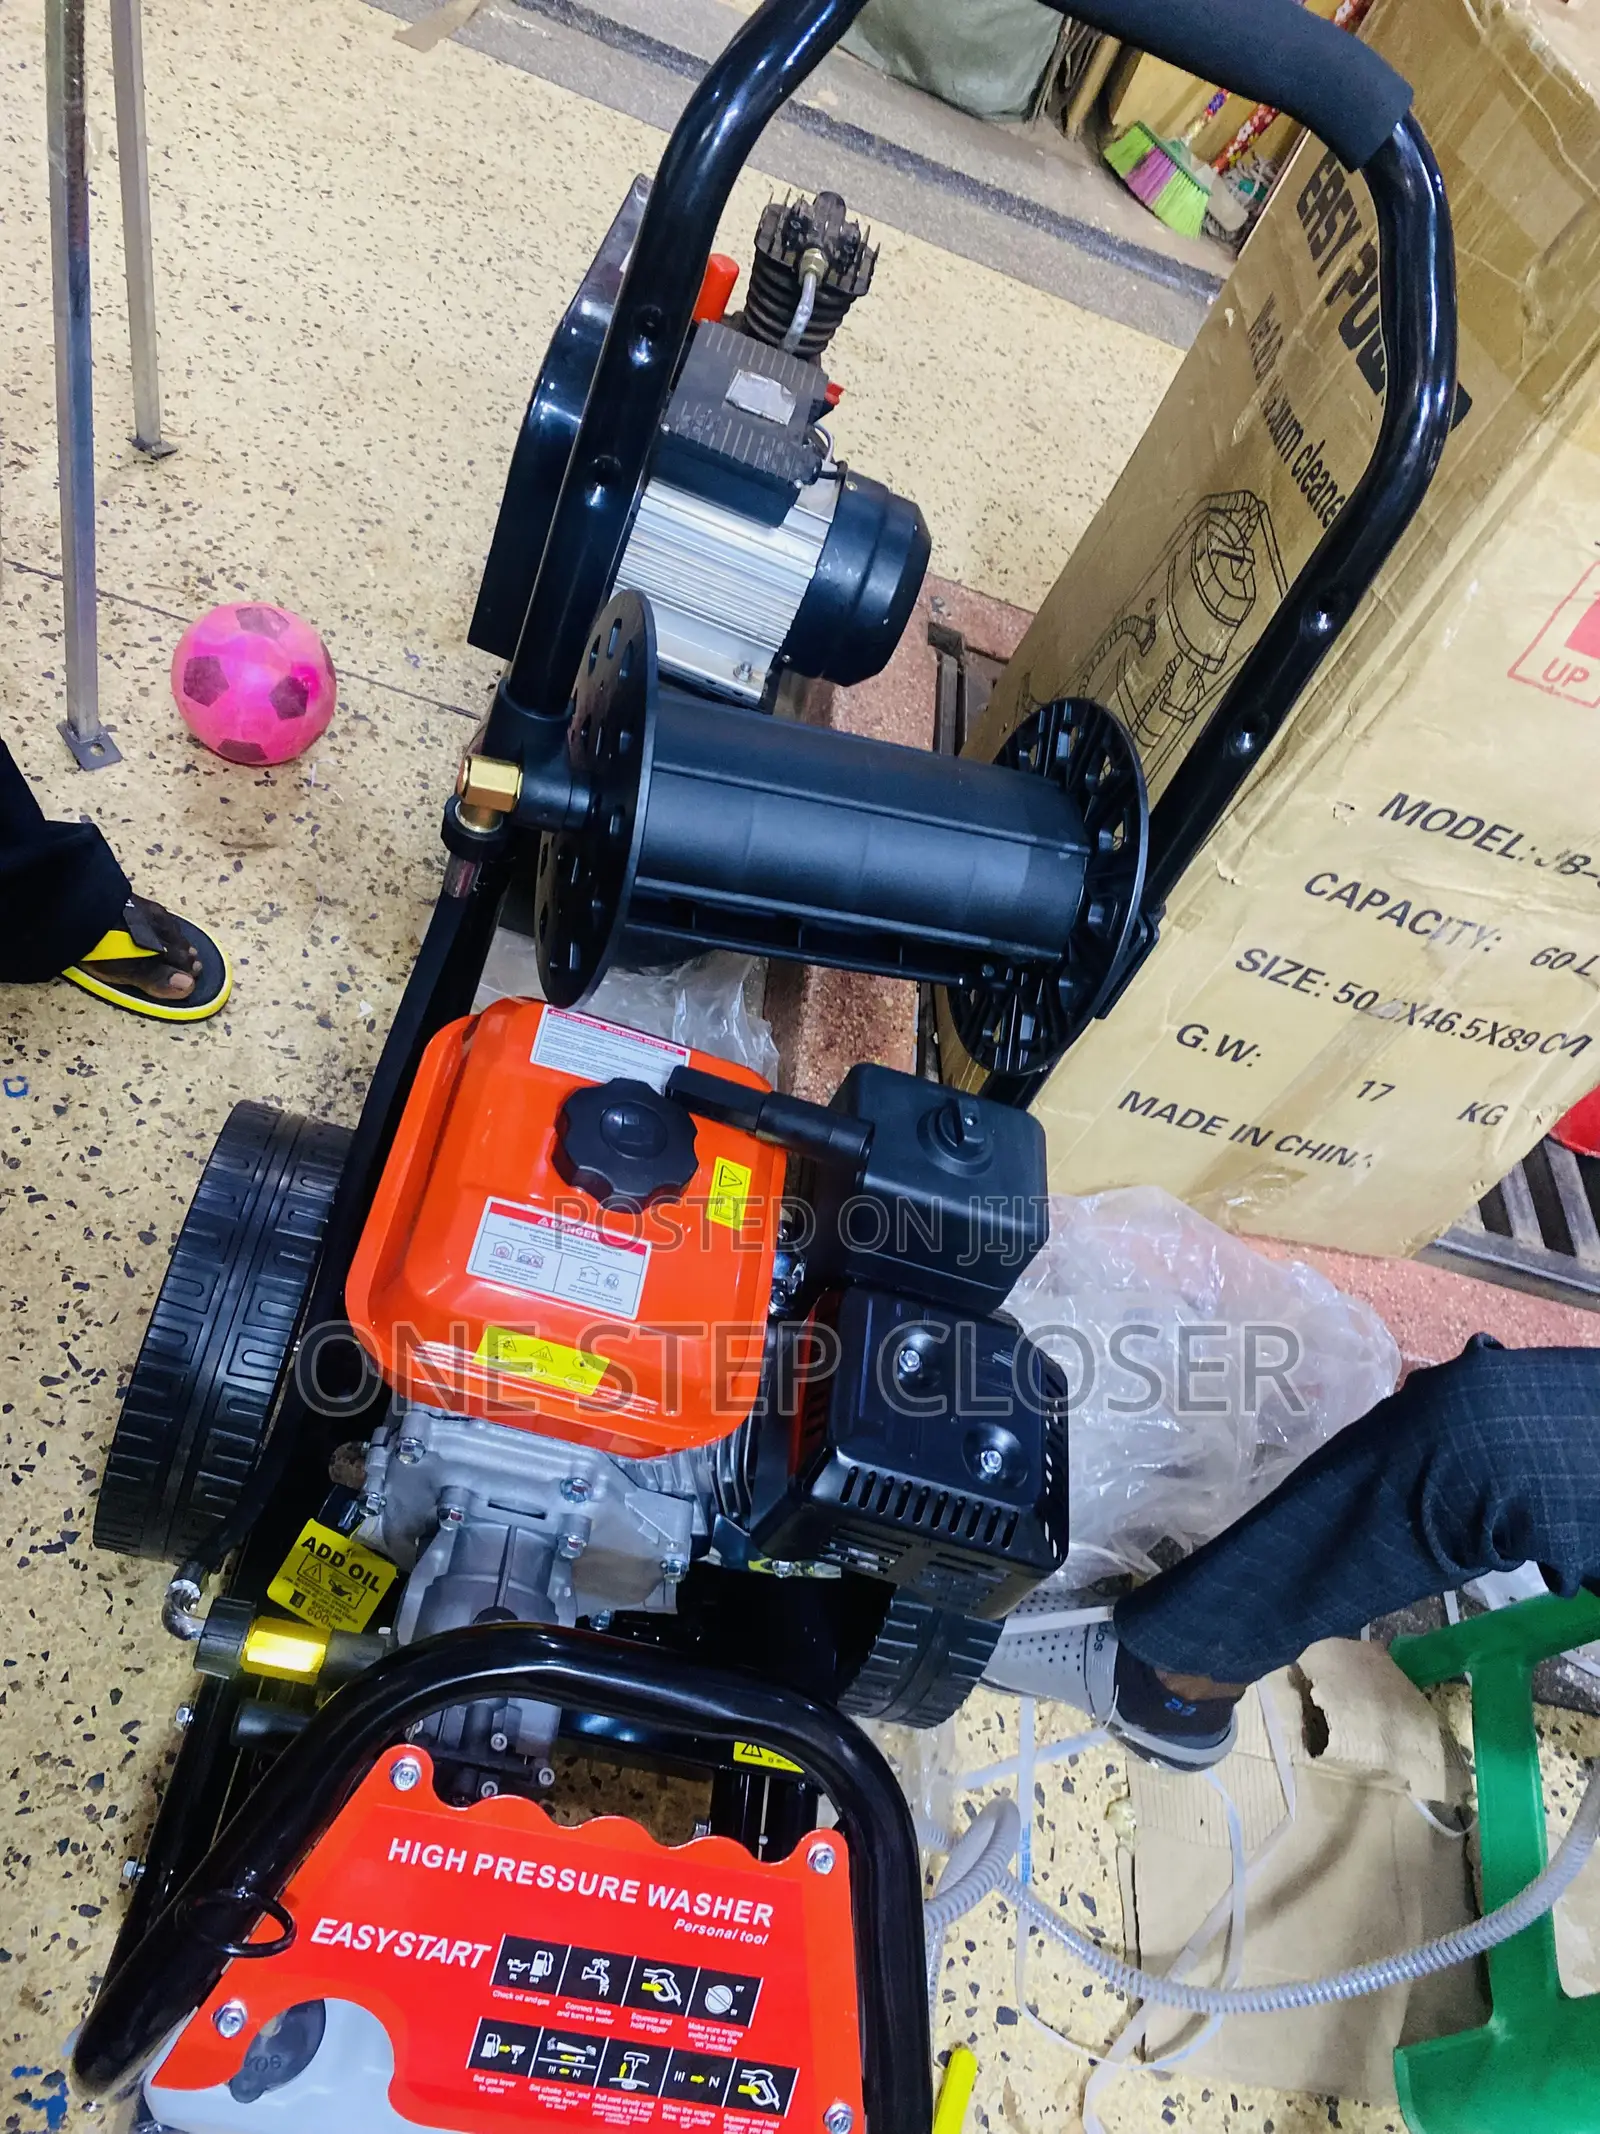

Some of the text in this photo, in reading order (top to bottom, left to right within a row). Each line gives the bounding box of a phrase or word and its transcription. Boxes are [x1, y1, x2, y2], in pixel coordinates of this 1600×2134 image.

[1296, 150, 1362, 279] EASY
[1291, 439, 1347, 529] cleane
[1542, 657, 1590, 687] UP
[1378, 792, 1537, 861] MODEL:
[1305, 873, 1501, 952] CAPACITY:
[1236, 948, 1330, 998] SIZE:
[1176, 1023, 1508, 1126] G.W: 17 KG
[1118, 1090, 1229, 1136] MADE
[1229, 1123, 1274, 1148] IN
[551, 1221, 600, 1242] DANGER
[301, 1536, 380, 1593] ADD OIL
[387, 1837, 774, 1928] HIGH PRESSURE WASHER
[310, 1917, 492, 1969] EASYSTART
[674, 1918, 770, 1946] Personal tool
[493, 1989, 513, 2000] Check
[565, 2002, 593, 2014] Connect
